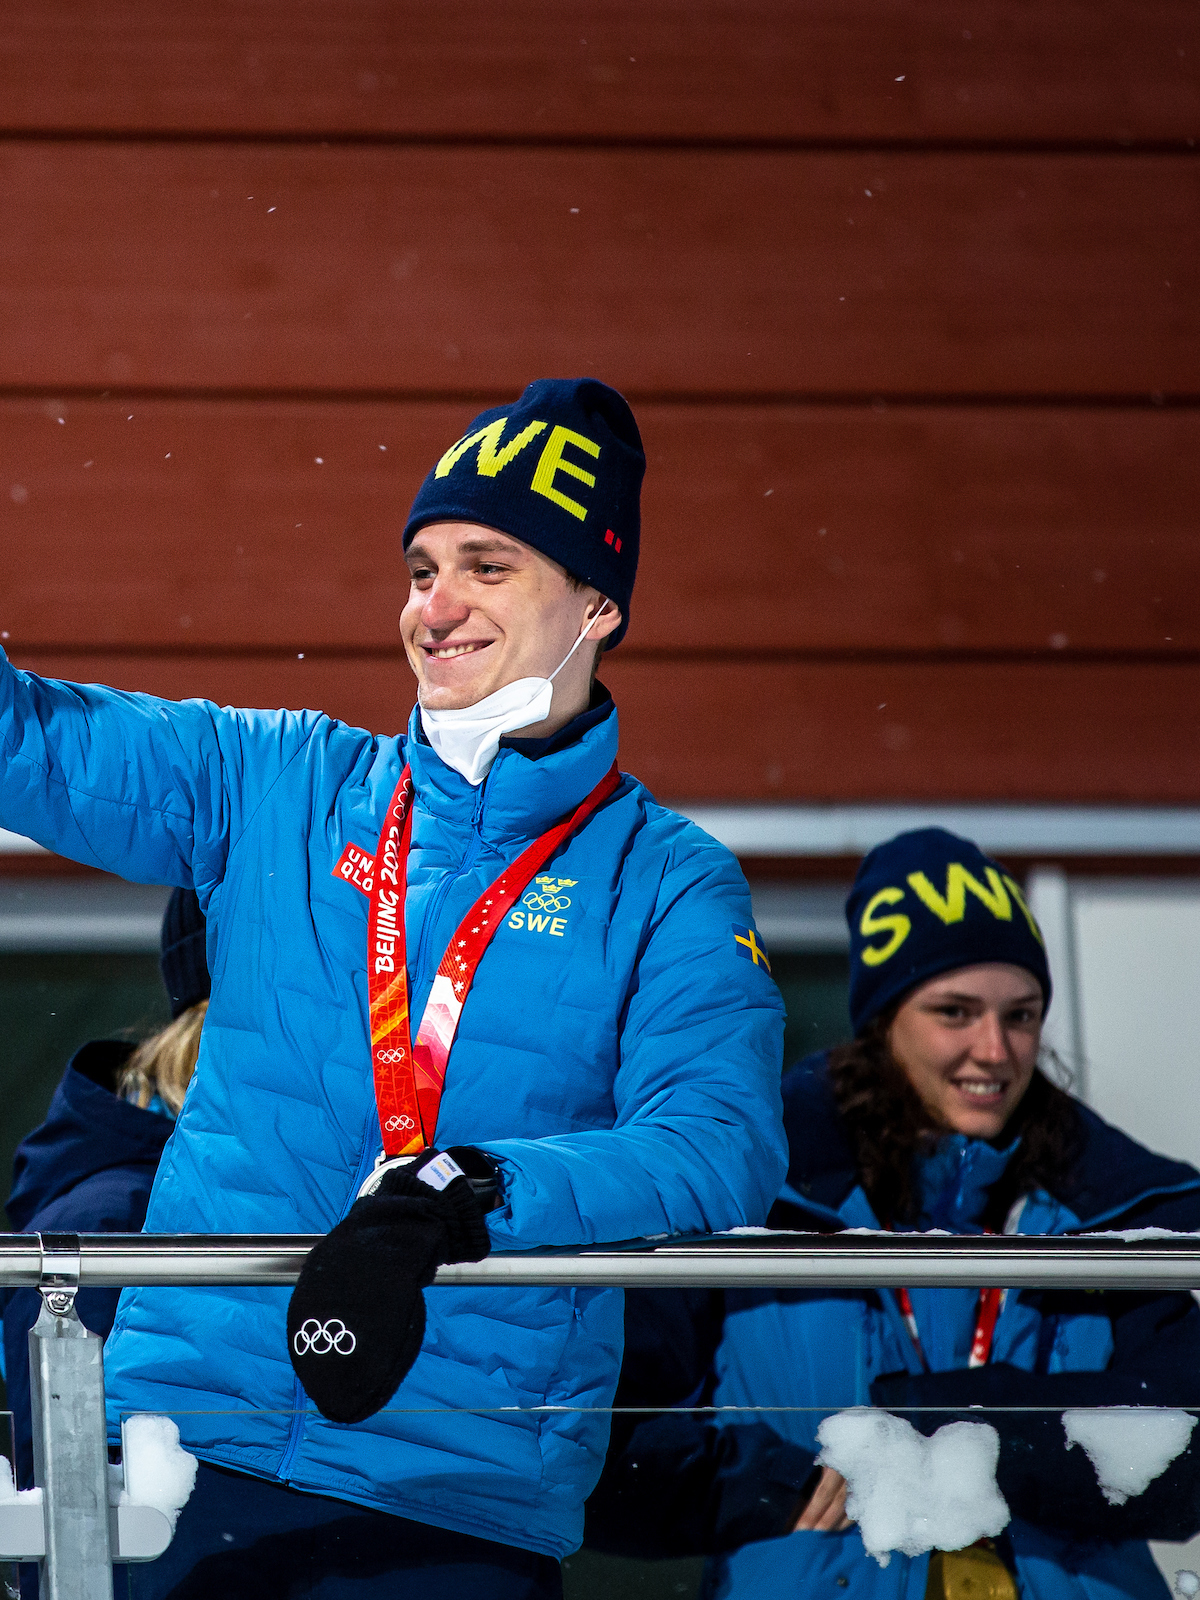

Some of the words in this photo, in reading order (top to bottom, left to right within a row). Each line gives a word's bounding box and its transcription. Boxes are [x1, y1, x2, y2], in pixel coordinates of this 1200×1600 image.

[348, 848, 375, 877] UN
[380, 825, 401, 886] 2022
[340, 861, 374, 892] QLO
[375, 888, 401, 975] BEIJING
[508, 911, 568, 937] SWE
